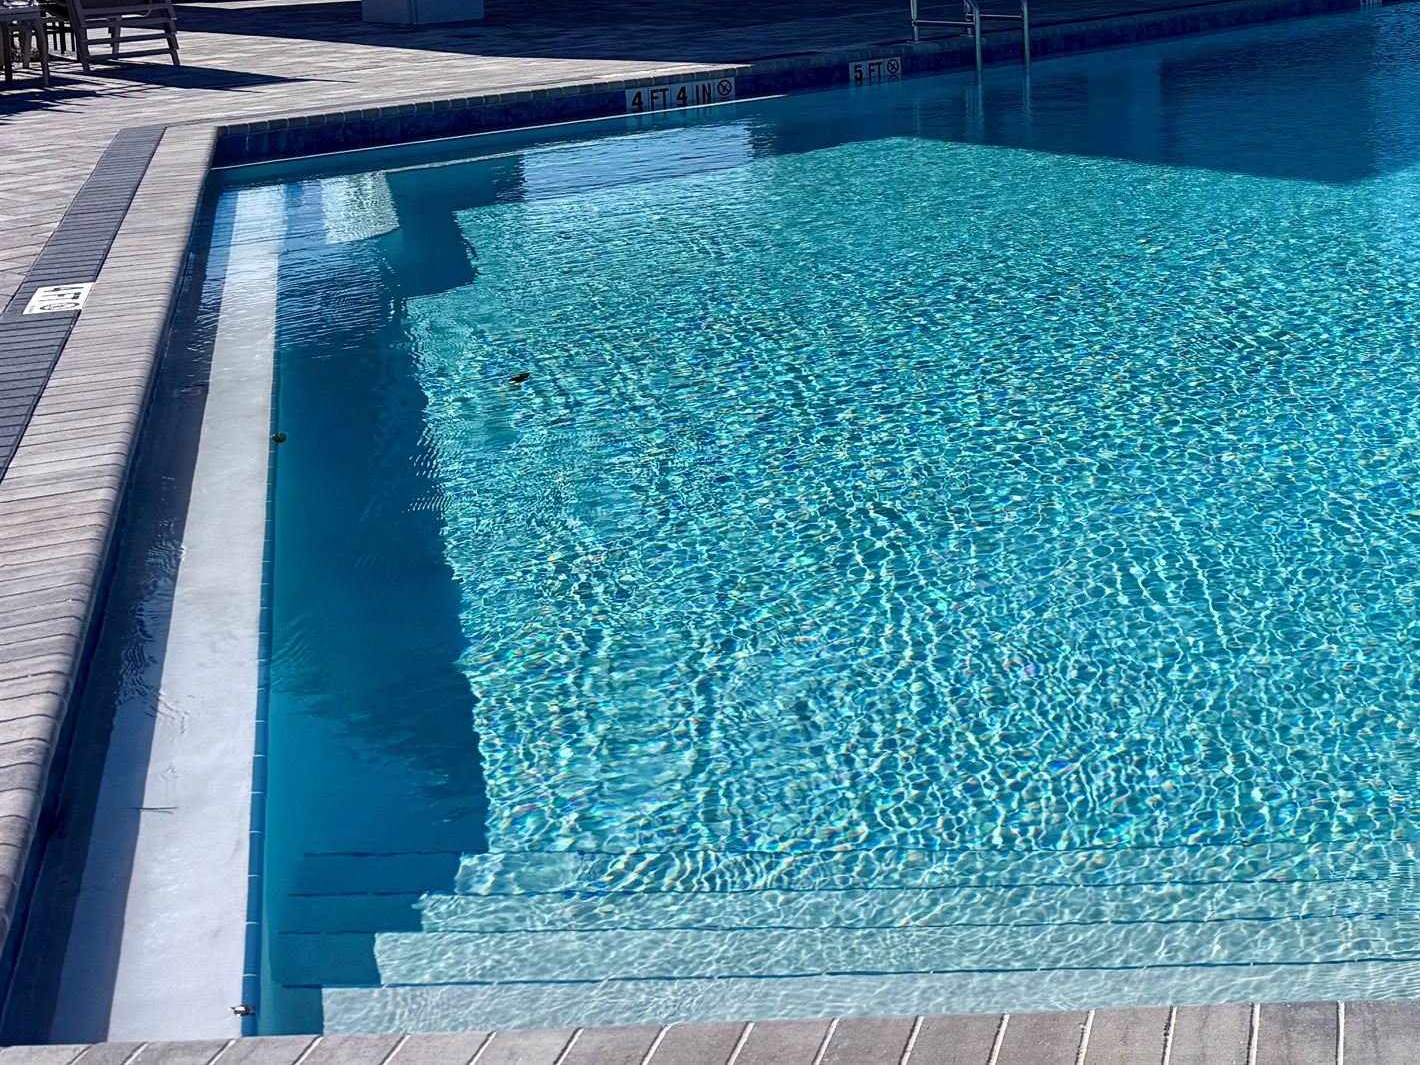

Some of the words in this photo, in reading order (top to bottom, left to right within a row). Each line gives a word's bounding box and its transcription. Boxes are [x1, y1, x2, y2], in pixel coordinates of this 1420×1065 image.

[853, 64, 863, 81] 5
[868, 61, 883, 80] FT
[631, 91, 643, 109] 4
[650, 87, 669, 109] FT
[676, 85, 688, 105] 4
[695, 83, 712, 104] IN
